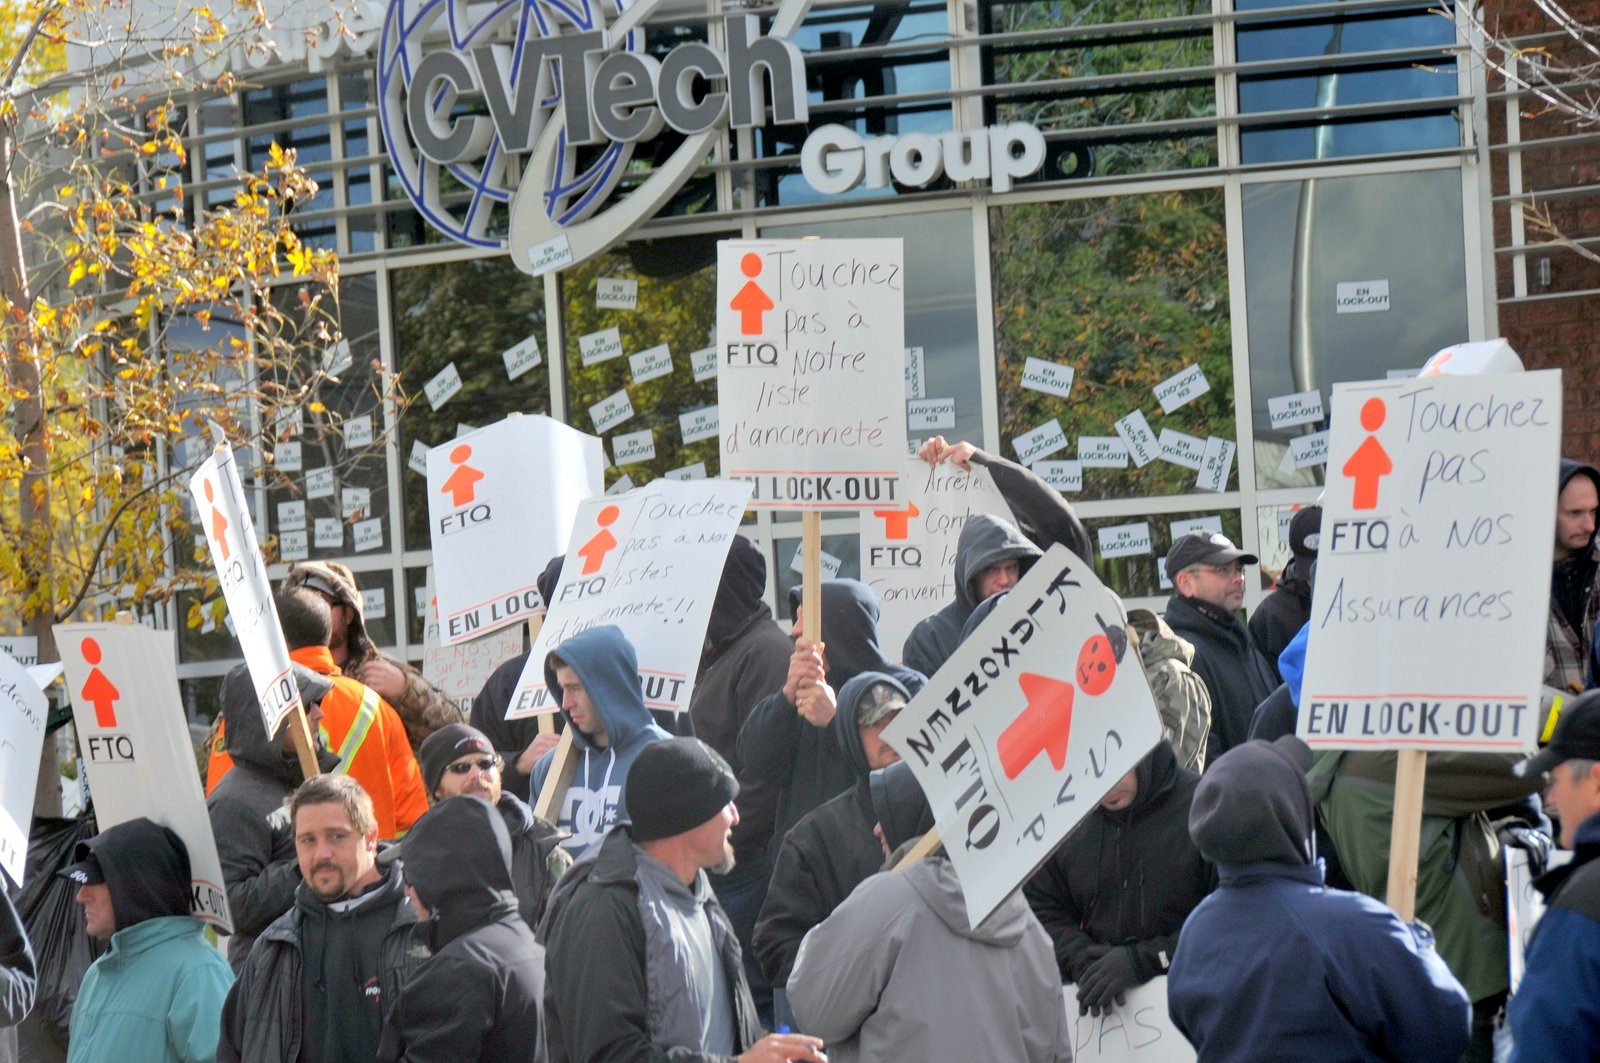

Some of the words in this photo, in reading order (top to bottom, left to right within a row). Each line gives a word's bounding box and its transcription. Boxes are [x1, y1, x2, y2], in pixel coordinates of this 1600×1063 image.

[801, 121, 1046, 193] Group
[767, 249, 901, 300] Touchez
[783, 308, 826, 350] pas
[727, 343, 778, 365] FTQ
[1023, 373, 1071, 391] LOCK-OUT
[1042, 368, 1055, 377] EN
[757, 380, 812, 412] liste
[1288, 400, 1302, 409] EN
[1271, 406, 1322, 421] LOCK-OUT
[1399, 386, 1549, 442] Touchez
[1019, 433, 1063, 461] LOCK-OUT
[1031, 434, 1044, 444] EN
[1138, 430, 1148, 443] EN
[1177, 440, 1190, 449] EN
[1311, 439, 1324, 448] EN
[1079, 452, 1127, 460] LOCK-OUT
[1419, 449, 1489, 504] pas
[772, 477, 899, 500] LOCK-OUT
[440, 504, 491, 534] FTQ
[1101, 539, 1149, 551] LOCK-OUT
[1117, 532, 1130, 540] EN
[1330, 520, 1389, 550] FTQ
[870, 547, 921, 566] FTQ
[559, 577, 606, 601] FTQ
[1321, 576, 1513, 629] Assurances
[449, 610, 480, 637] EN
[516, 687, 548, 710] EN
[1307, 703, 1349, 735] EN
[1362, 702, 1527, 737] LOCK-OUT
[88, 736, 135, 760] FTQ
[939, 734, 1001, 852] FTQ
